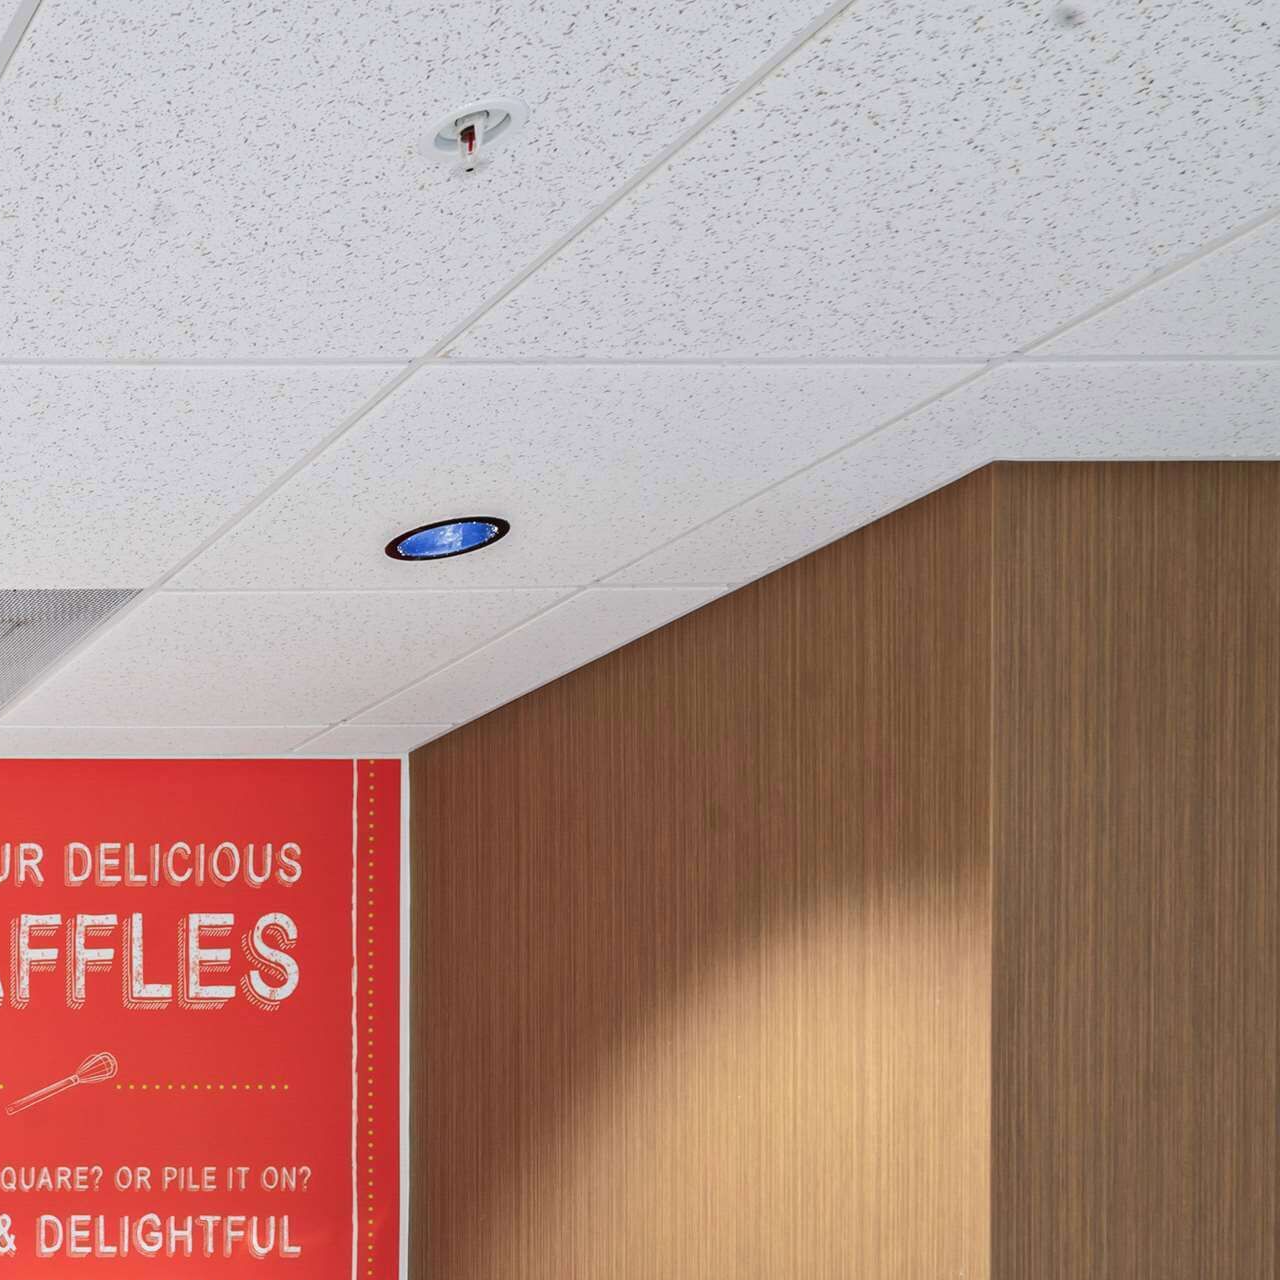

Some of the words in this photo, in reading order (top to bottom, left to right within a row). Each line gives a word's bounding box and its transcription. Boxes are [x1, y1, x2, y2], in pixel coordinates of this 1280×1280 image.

[65, 841, 302, 888] DELICIOUS
[115, 1166, 151, 1191] OR
[163, 1166, 216, 1192] PILE
[227, 1167, 250, 1191] IT
[261, 1166, 312, 1191] ON?
[37, 1213, 302, 1259] DELIGHTFUL
